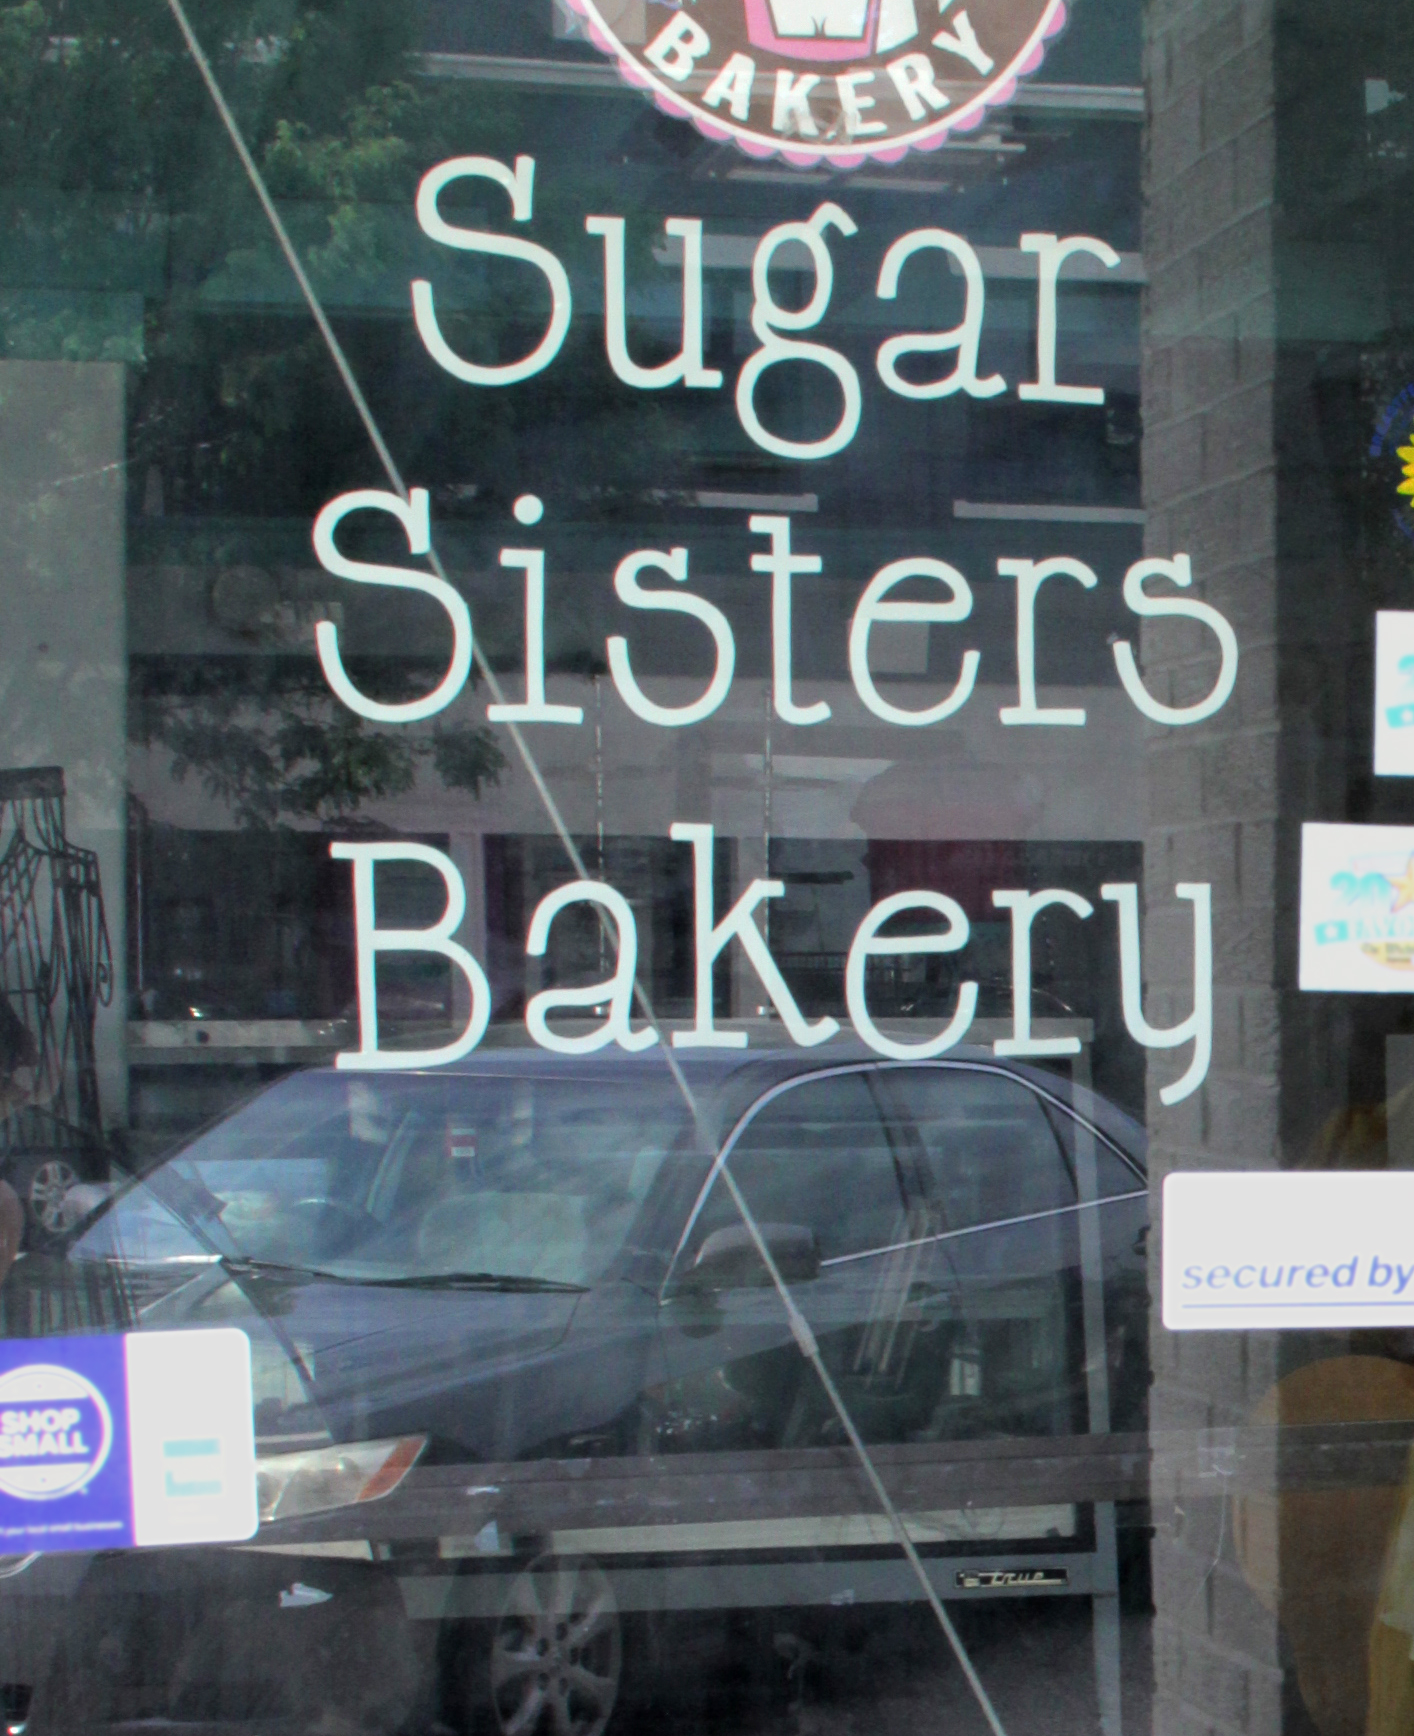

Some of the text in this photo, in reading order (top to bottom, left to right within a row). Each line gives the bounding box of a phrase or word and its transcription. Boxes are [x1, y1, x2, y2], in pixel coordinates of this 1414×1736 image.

[644, 9, 994, 136] BAKERY
[411, 155, 1120, 458] Sugar
[313, 487, 1238, 725] Sisters
[330, 821, 1212, 1106] Bakery
[1181, 1255, 1360, 1291] secured
[0, 1430, 90, 1458] SMALL
[1, 1407, 82, 1435] SHOP
